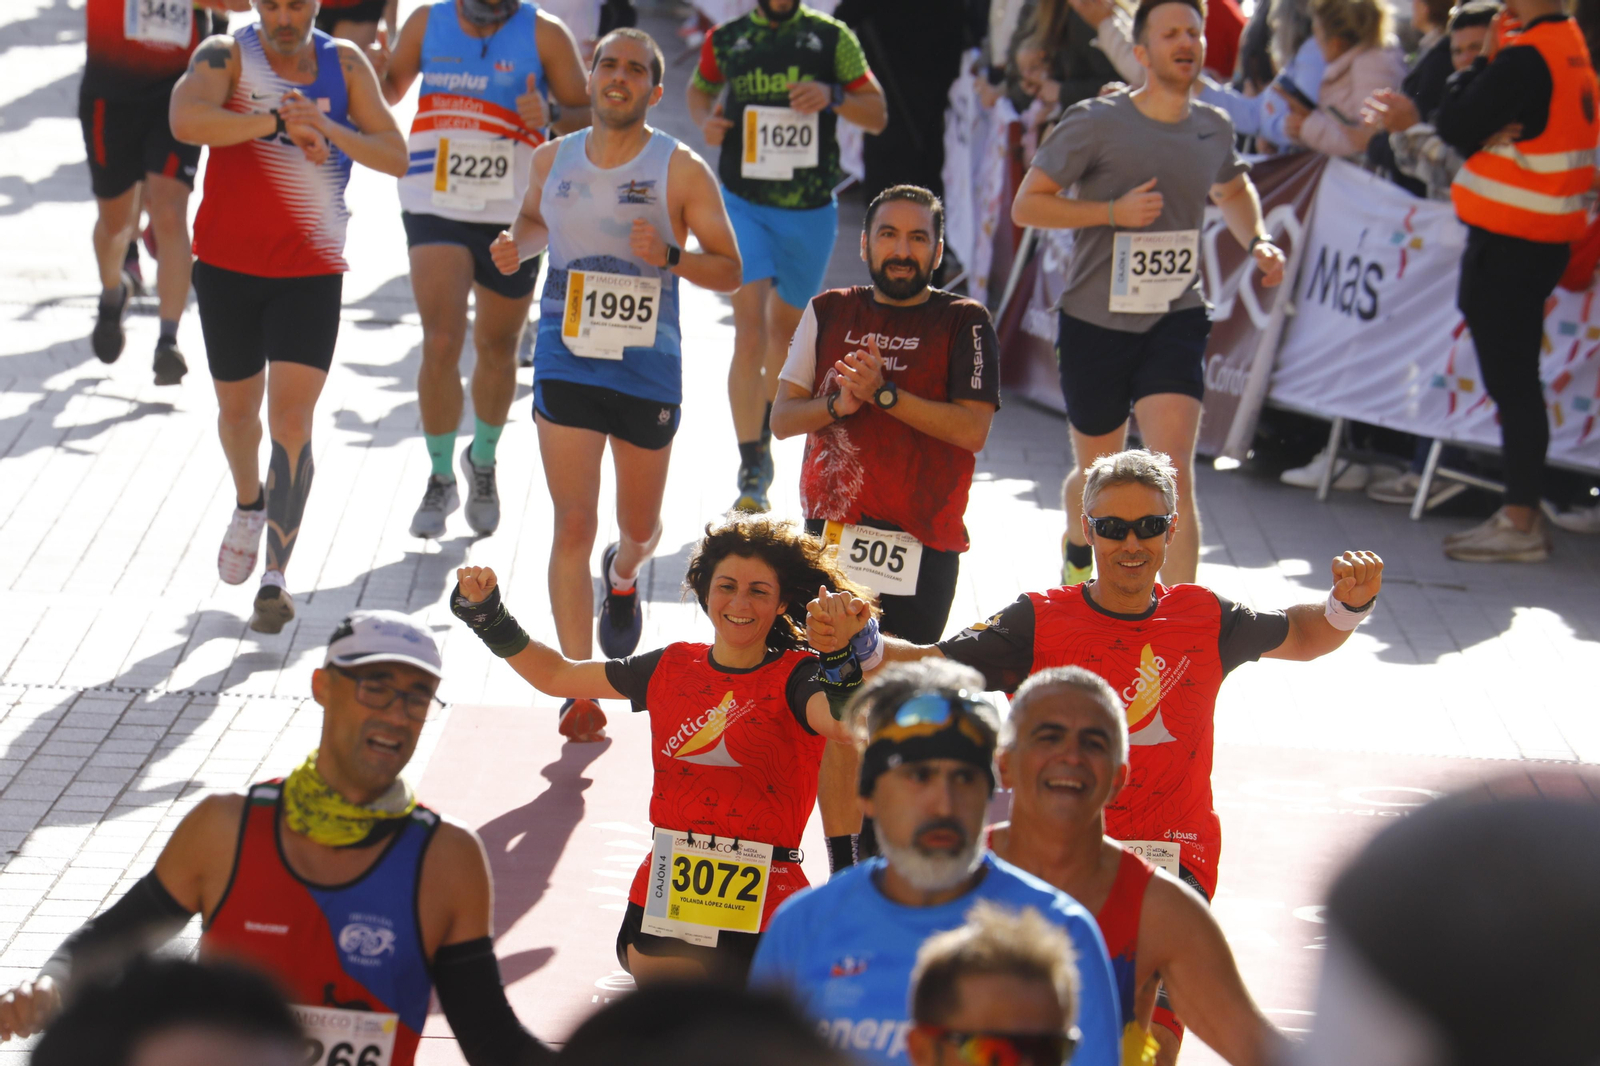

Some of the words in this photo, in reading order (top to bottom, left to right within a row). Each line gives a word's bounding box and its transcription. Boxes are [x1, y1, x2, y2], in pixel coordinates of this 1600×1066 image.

[760, 124, 812, 147] 1620
[450, 153, 508, 178] 2229
[1132, 249, 1192, 275] 3532
[586, 290, 654, 323] 1995
[843, 330, 920, 350] LOBOS
[970, 324, 983, 390] LOBOS
[849, 538, 907, 572] 505
[1173, 655, 1187, 674] escalada
[1152, 667, 1172, 690] deportivo
[1163, 829, 1198, 841] dobuss
[655, 863, 666, 899] CAJÓN
[672, 856, 761, 902] 3072
[680, 896, 704, 906] YOLANDA
[704, 900, 723, 909] LÓPEZ
[723, 902, 746, 912] GÁLVEZ
